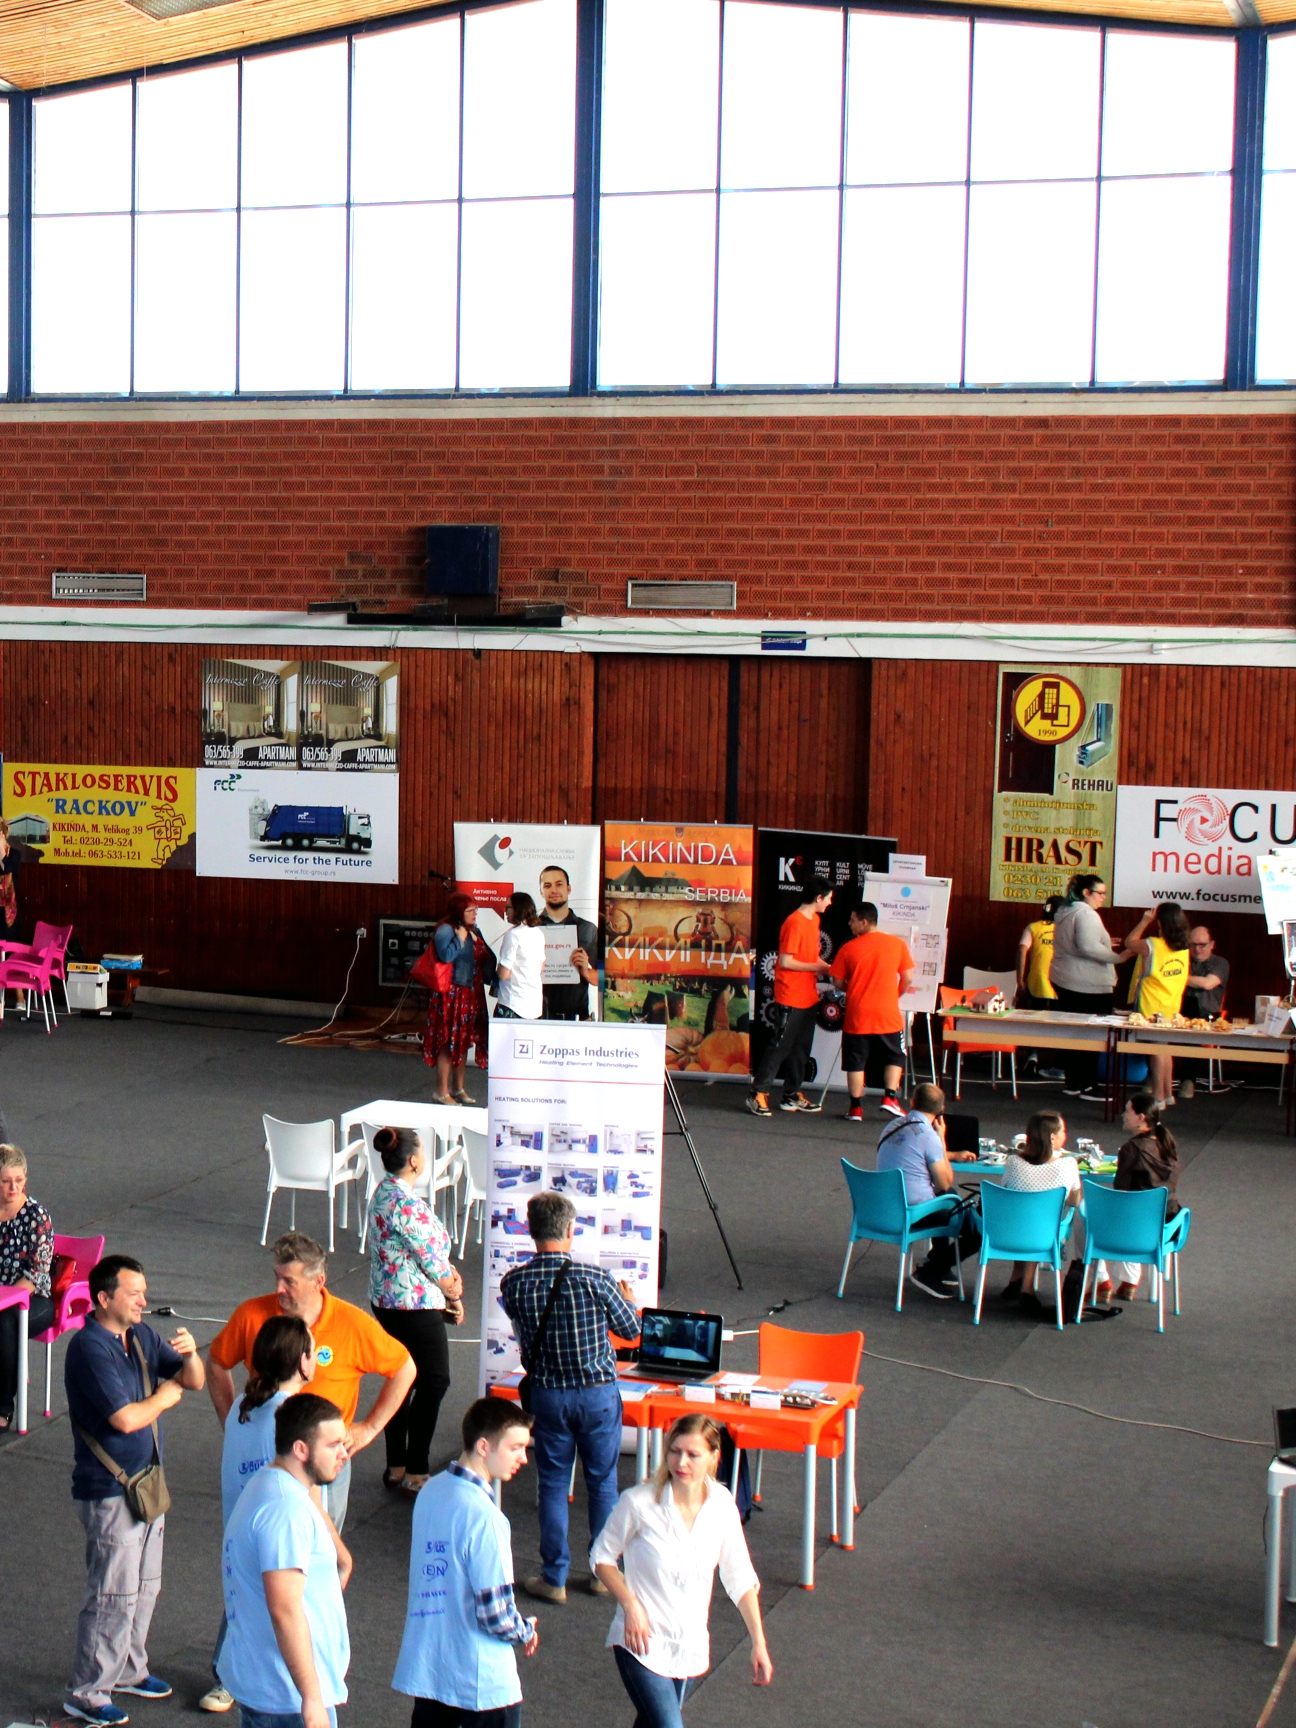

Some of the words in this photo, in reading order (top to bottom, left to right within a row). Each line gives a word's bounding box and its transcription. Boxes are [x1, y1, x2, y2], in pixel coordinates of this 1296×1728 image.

[1037, 728, 1058, 737] 1990
[258, 746, 297, 760] APARTMANI
[356, 748, 396, 762] APARTMANI
[13, 770, 179, 803] STAKLOSERVIS
[214, 779, 236, 791] FCC
[1071, 778, 1114, 792] REHAU
[1012, 810, 1039, 820] PVC
[91, 824, 101, 833] M.
[103, 824, 130, 835] Velikog
[132, 826, 143, 834] 39
[1011, 824, 1051, 834] drvena
[1053, 827, 1101, 838] stolarija
[79, 836, 133, 847] 0230-29-524
[88, 849, 141, 860] 063-533-121
[621, 840, 737, 866] KIKINDA
[1002, 835, 1105, 868] HRAST
[248, 853, 290, 864] Service
[293, 854, 310, 865] for
[313, 855, 331, 865] the
[334, 856, 372, 867] Future
[1151, 846, 1253, 877] media
[1004, 872, 1042, 885] 0230
[1044, 875, 1063, 887] 21
[684, 886, 747, 903] SERBIA
[1003, 886, 1031, 899] 063
[605, 935, 750, 970] КИКИНДА
[539, 1045, 580, 1058] Zoppas
[584, 1047, 639, 1059] Industries
